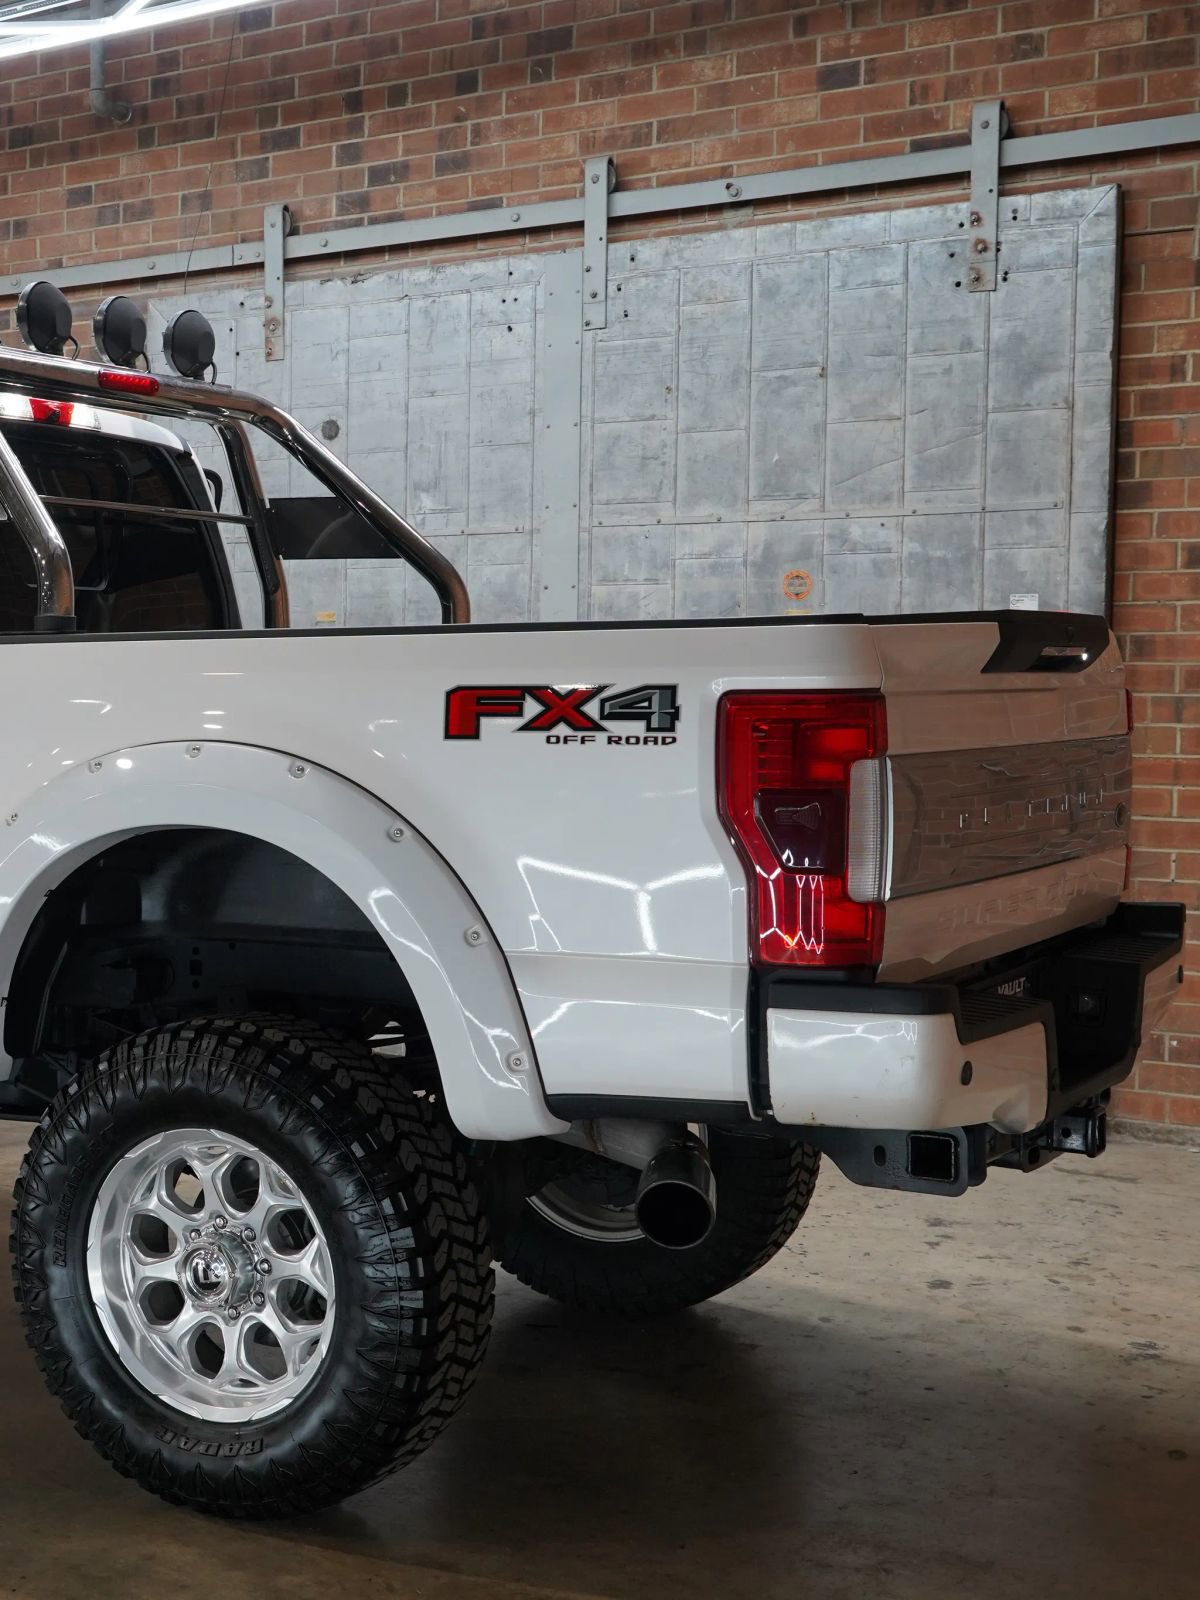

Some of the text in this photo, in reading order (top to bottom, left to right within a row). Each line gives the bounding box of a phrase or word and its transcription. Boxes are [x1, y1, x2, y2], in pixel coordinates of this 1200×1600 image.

[444, 684, 680, 740] FX4
[545, 735, 678, 746] OFF ROAD
[997, 976, 1026, 996] VAULT
